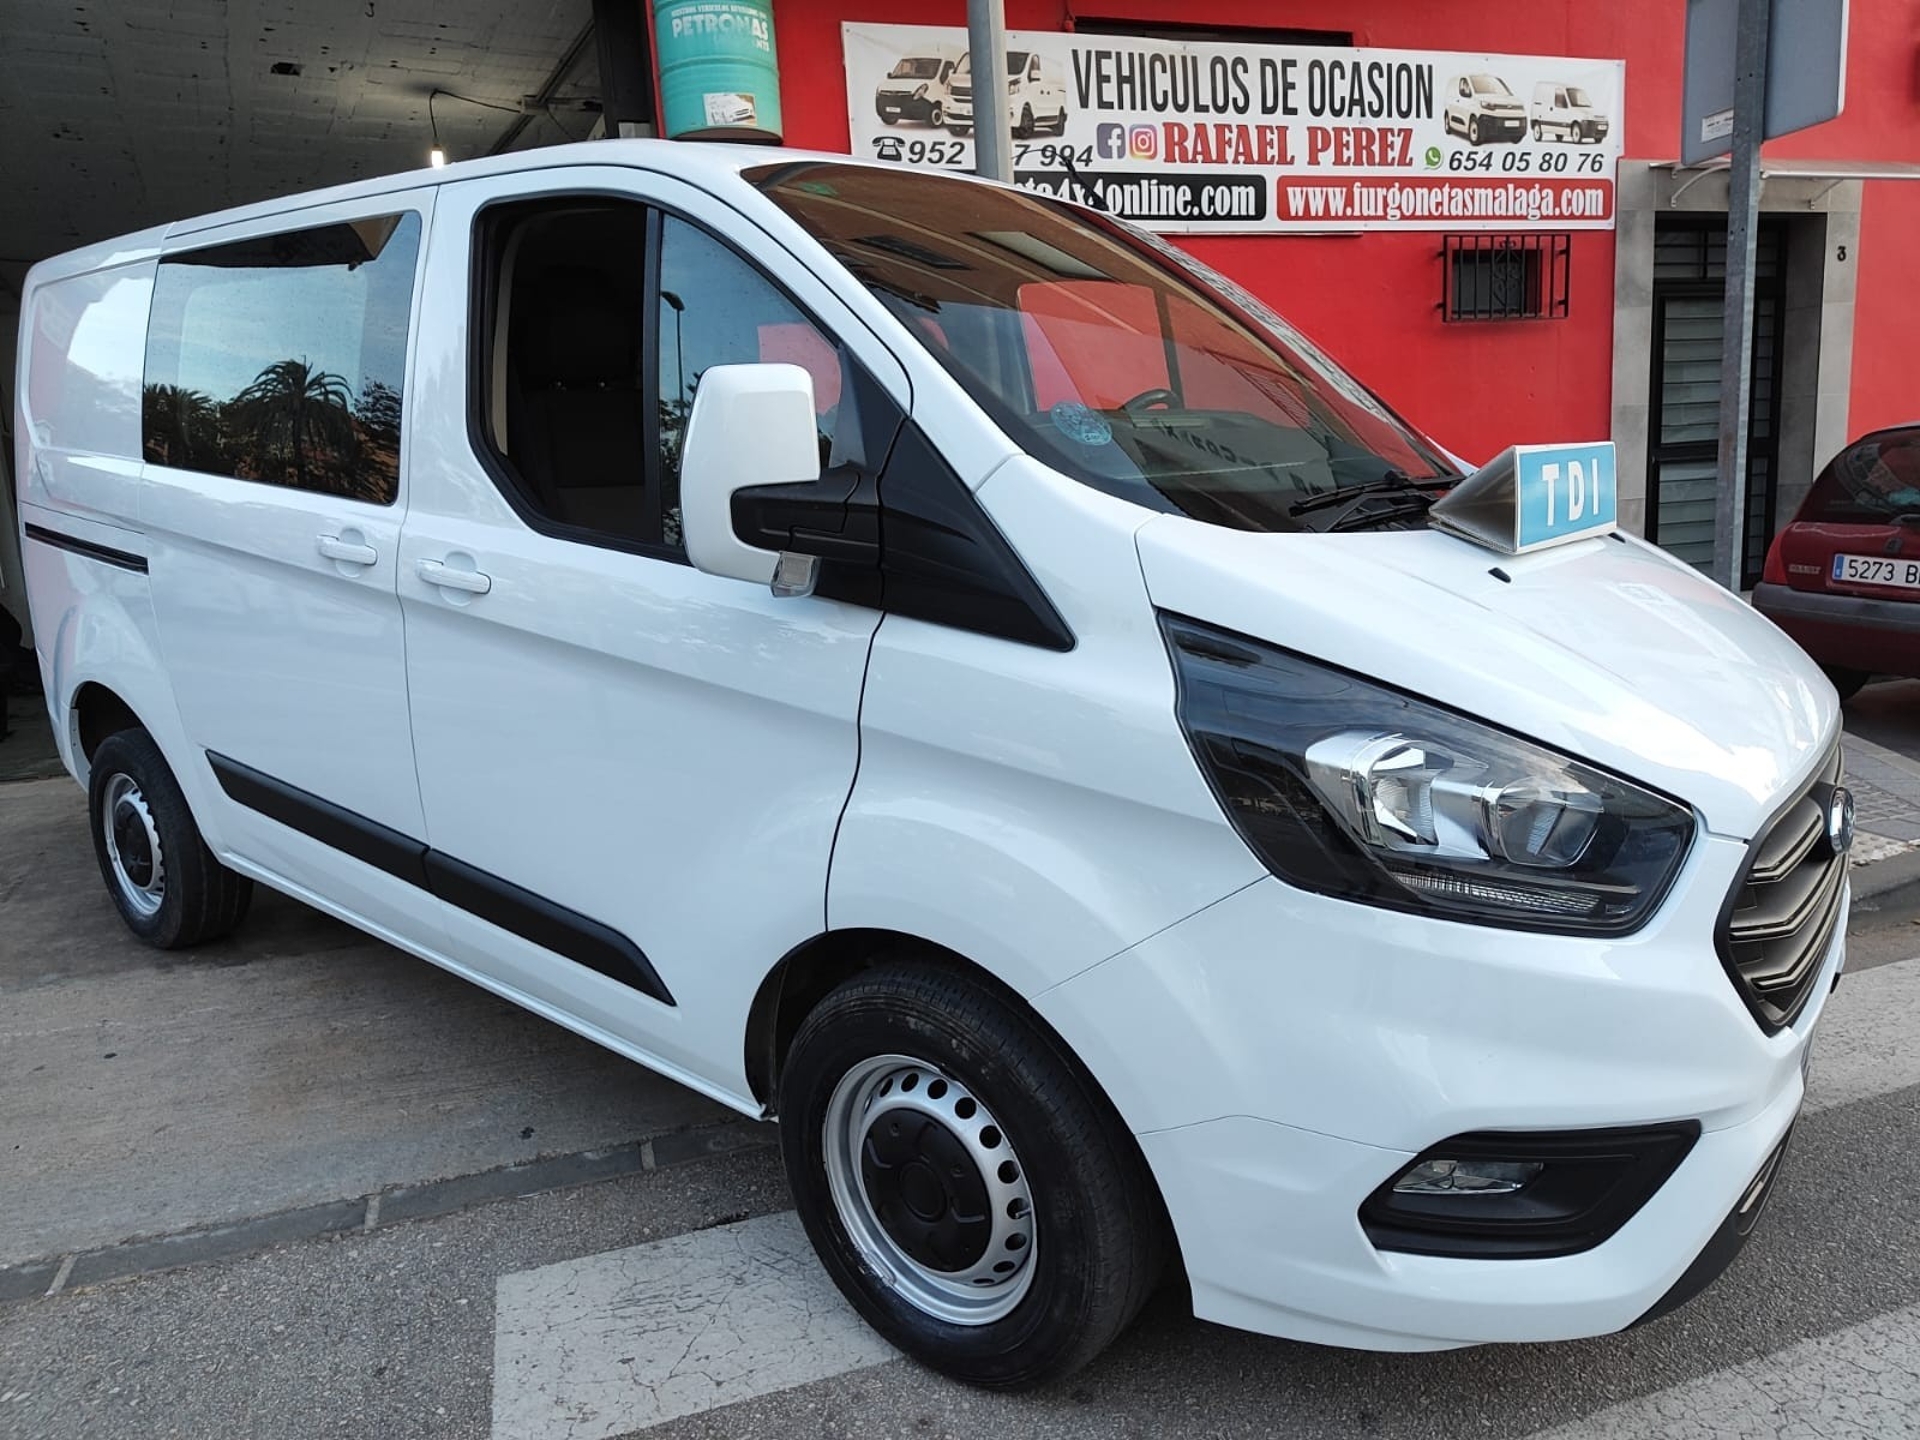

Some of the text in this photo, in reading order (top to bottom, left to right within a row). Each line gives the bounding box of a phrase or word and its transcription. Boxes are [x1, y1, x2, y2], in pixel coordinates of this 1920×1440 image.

[671, 13, 769, 41] PETRONAS
[1072, 49, 1433, 119] VEHICULOS DE OCASION
[908, 141, 965, 164] 952
[1040, 144, 1093, 167] 994
[1163, 122, 1413, 166] RAFAEL PEREZ
[1449, 151, 1604, 172] 654 05 80 76
[1286, 181, 1604, 220] www.furgonetasmalaga.com
[1837, 245, 1846, 261] 3
[1542, 458, 1599, 527] TDI
[1848, 560, 1895, 581] 5273
